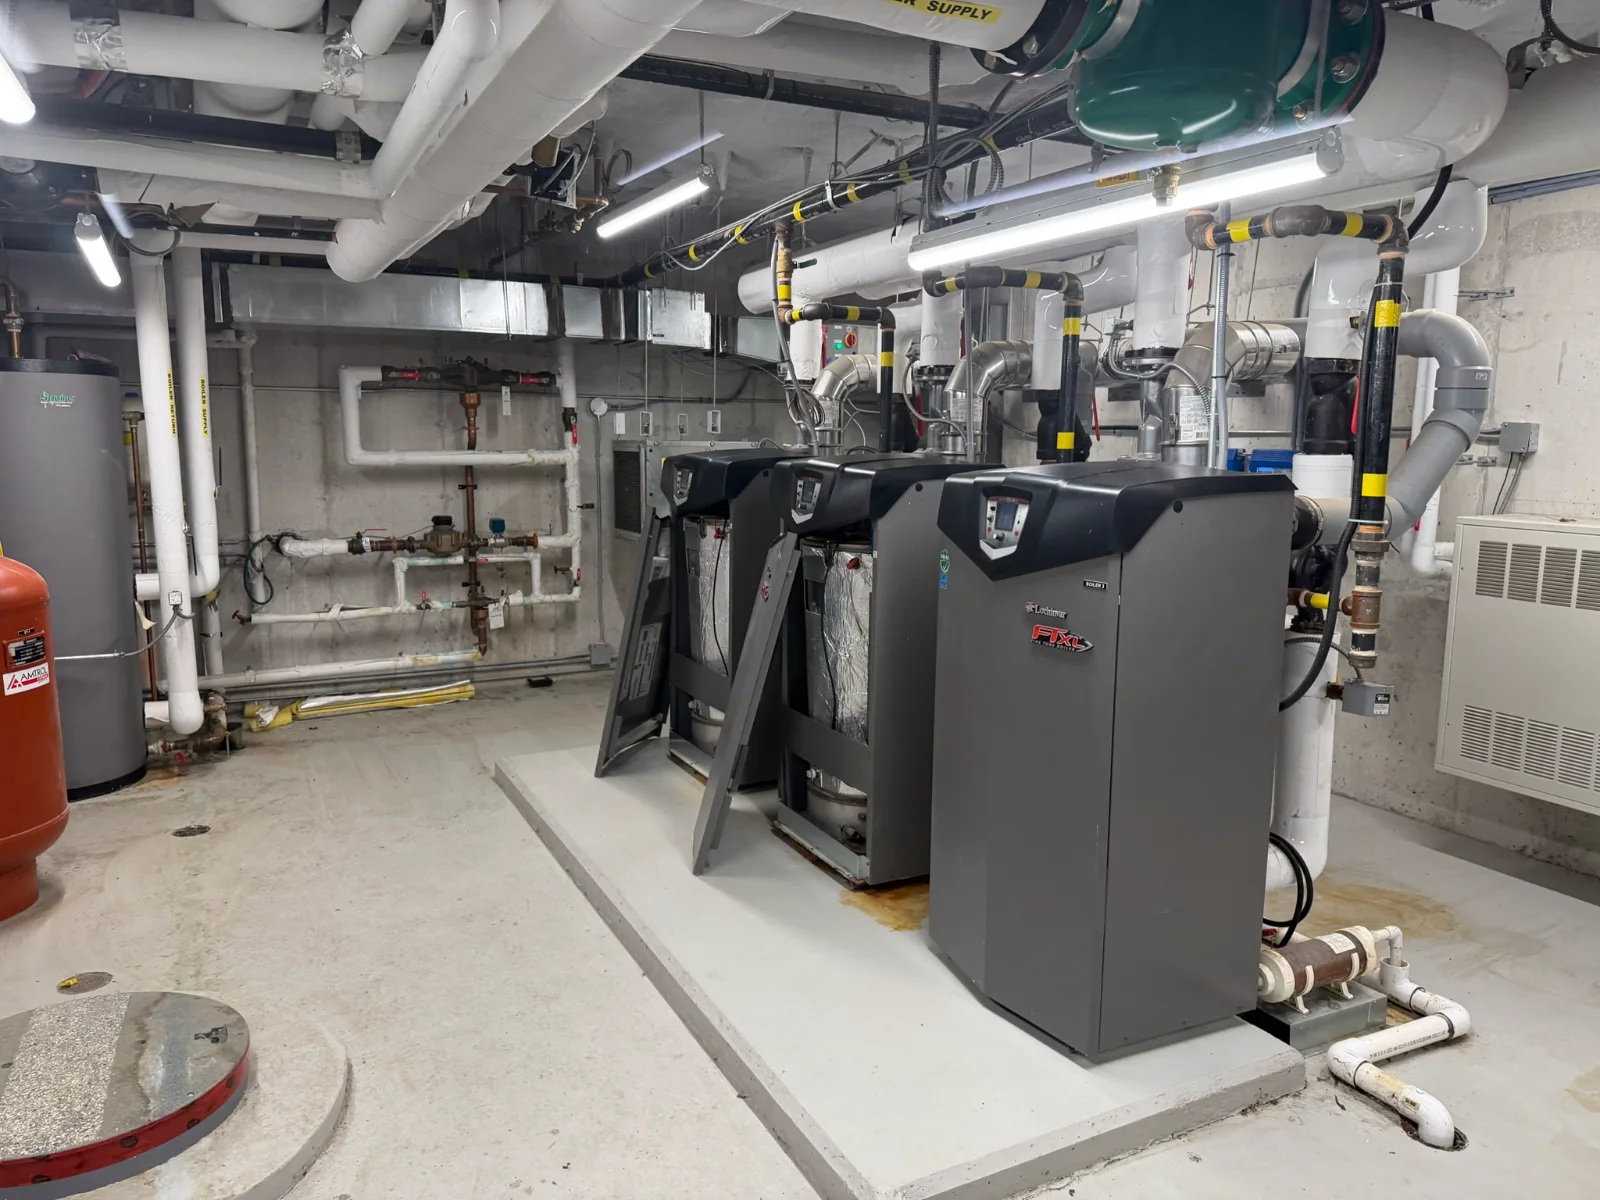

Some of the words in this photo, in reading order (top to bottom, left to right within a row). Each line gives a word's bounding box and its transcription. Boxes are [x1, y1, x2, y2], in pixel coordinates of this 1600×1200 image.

[926, 0, 992, 20] SUPPLY
[201, 408, 209, 435] SUPPLY
[1034, 604, 1067, 619] Lochinvar
[1056, 643, 1076, 652] BOILER
[20, 666, 47, 681] AMTROL
